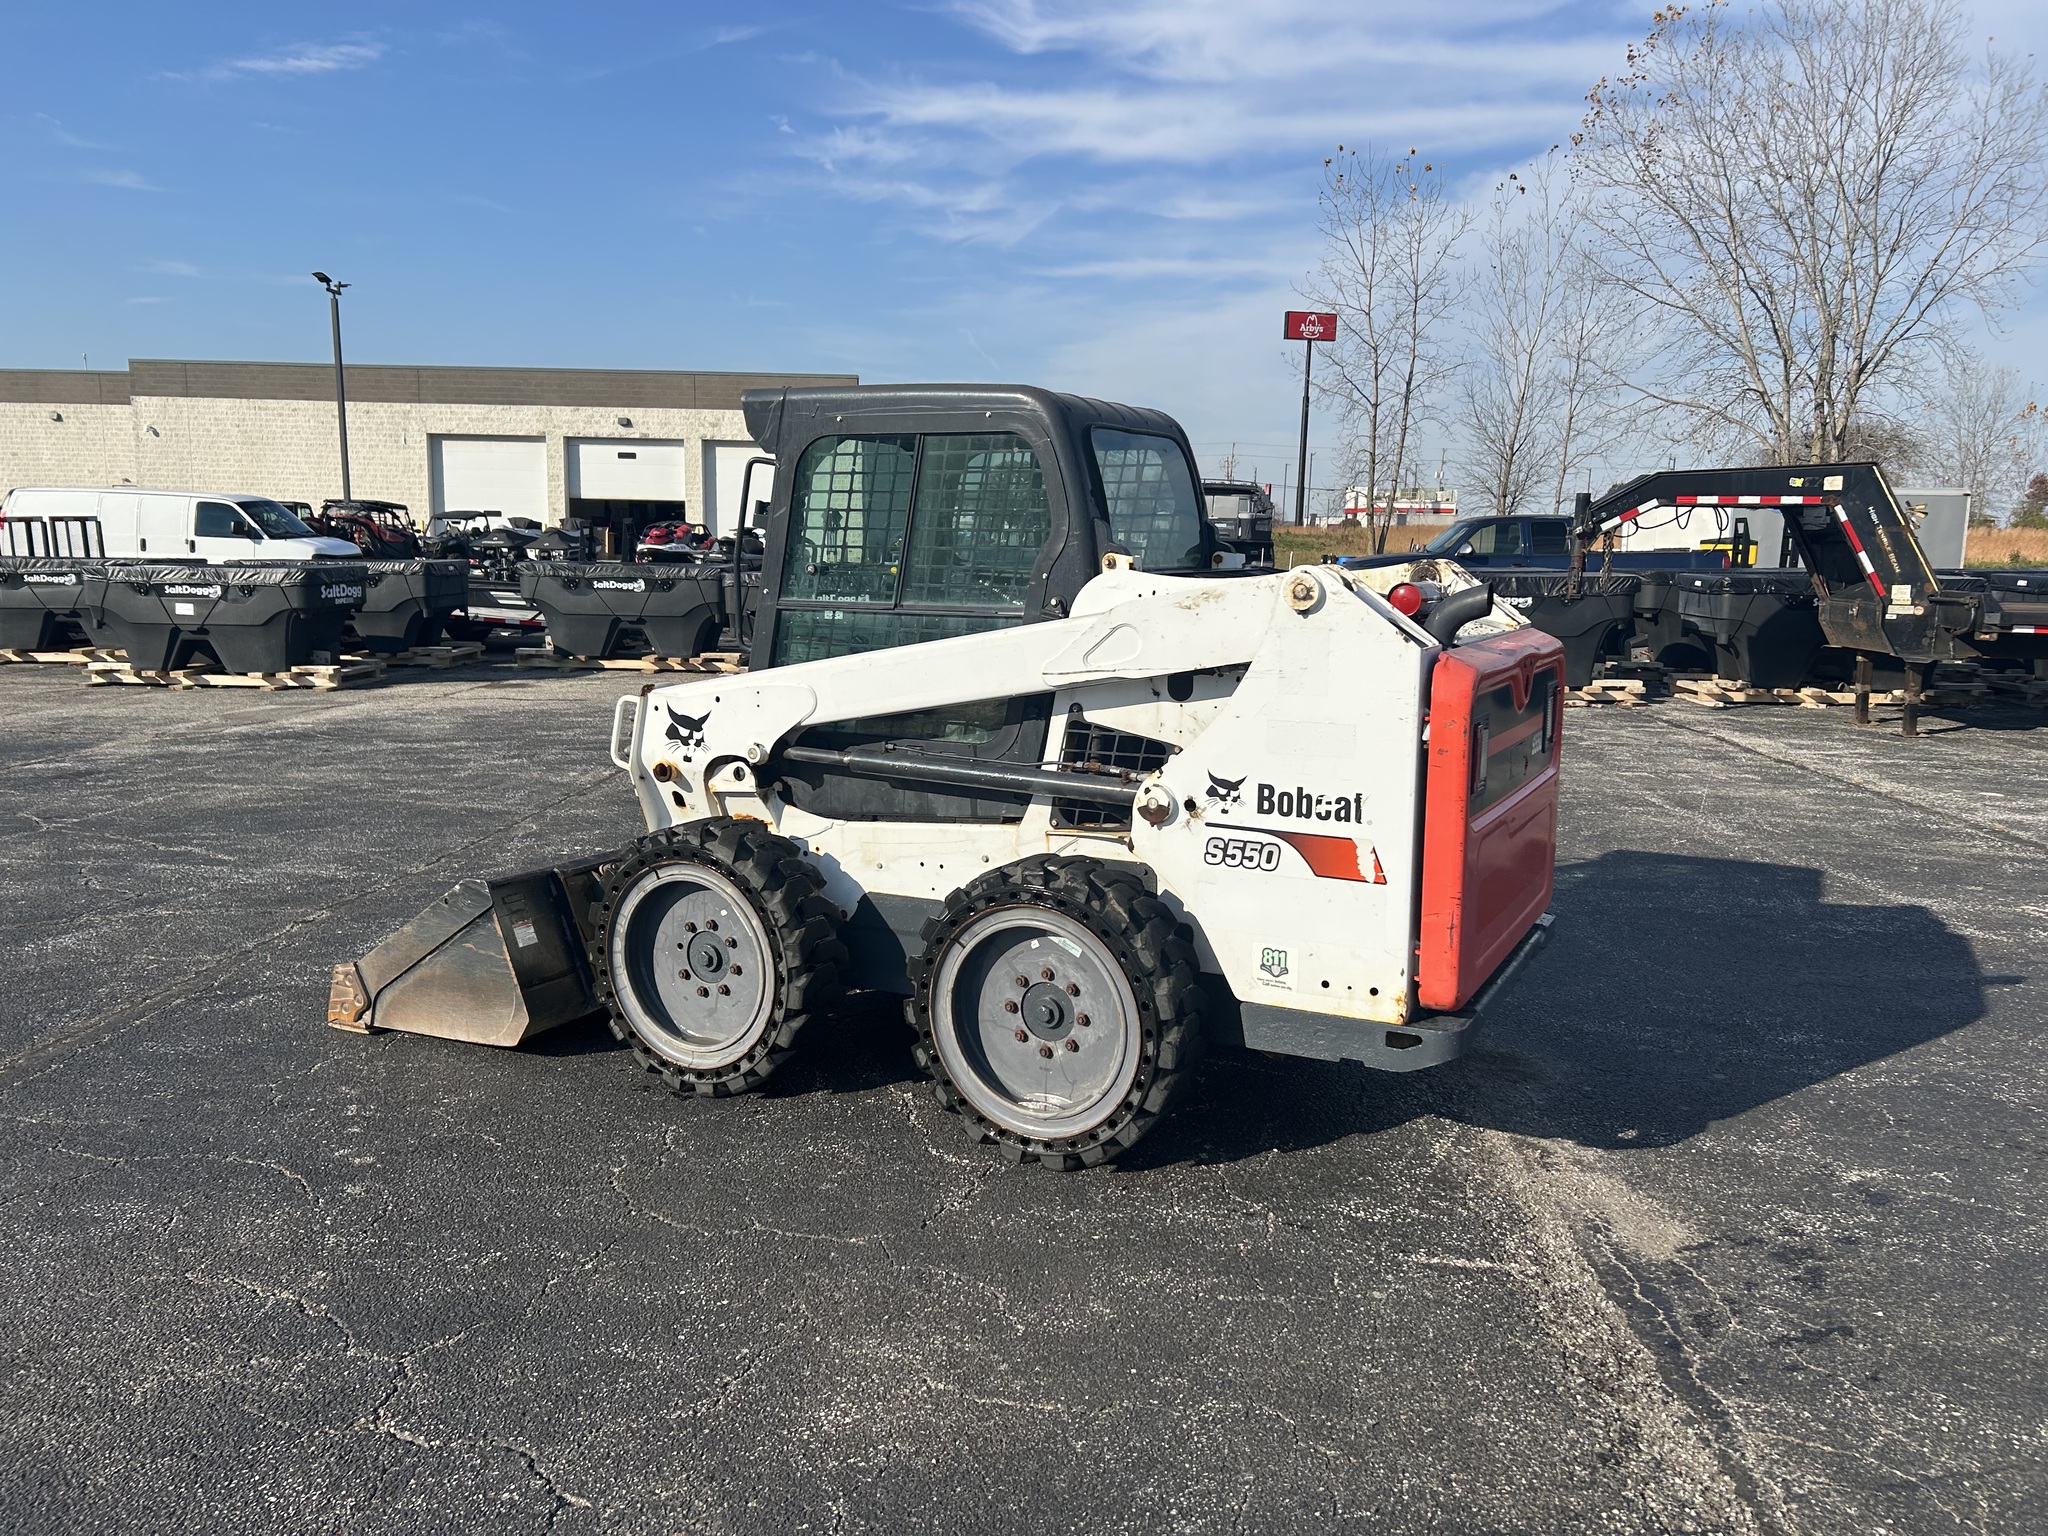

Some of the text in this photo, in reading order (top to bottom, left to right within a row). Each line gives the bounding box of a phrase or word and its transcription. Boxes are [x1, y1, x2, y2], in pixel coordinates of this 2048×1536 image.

[1300, 323, 1324, 334] Arby's
[23, 574, 65, 584] SaltDogg
[593, 580, 634, 590] SaltDogg
[164, 585, 209, 596] SaltDogg
[321, 584, 362, 598] SaltDogg
[1257, 783, 1363, 825] Bobcat
[1204, 837, 1282, 872] S550
[1262, 947, 1287, 968] 811
